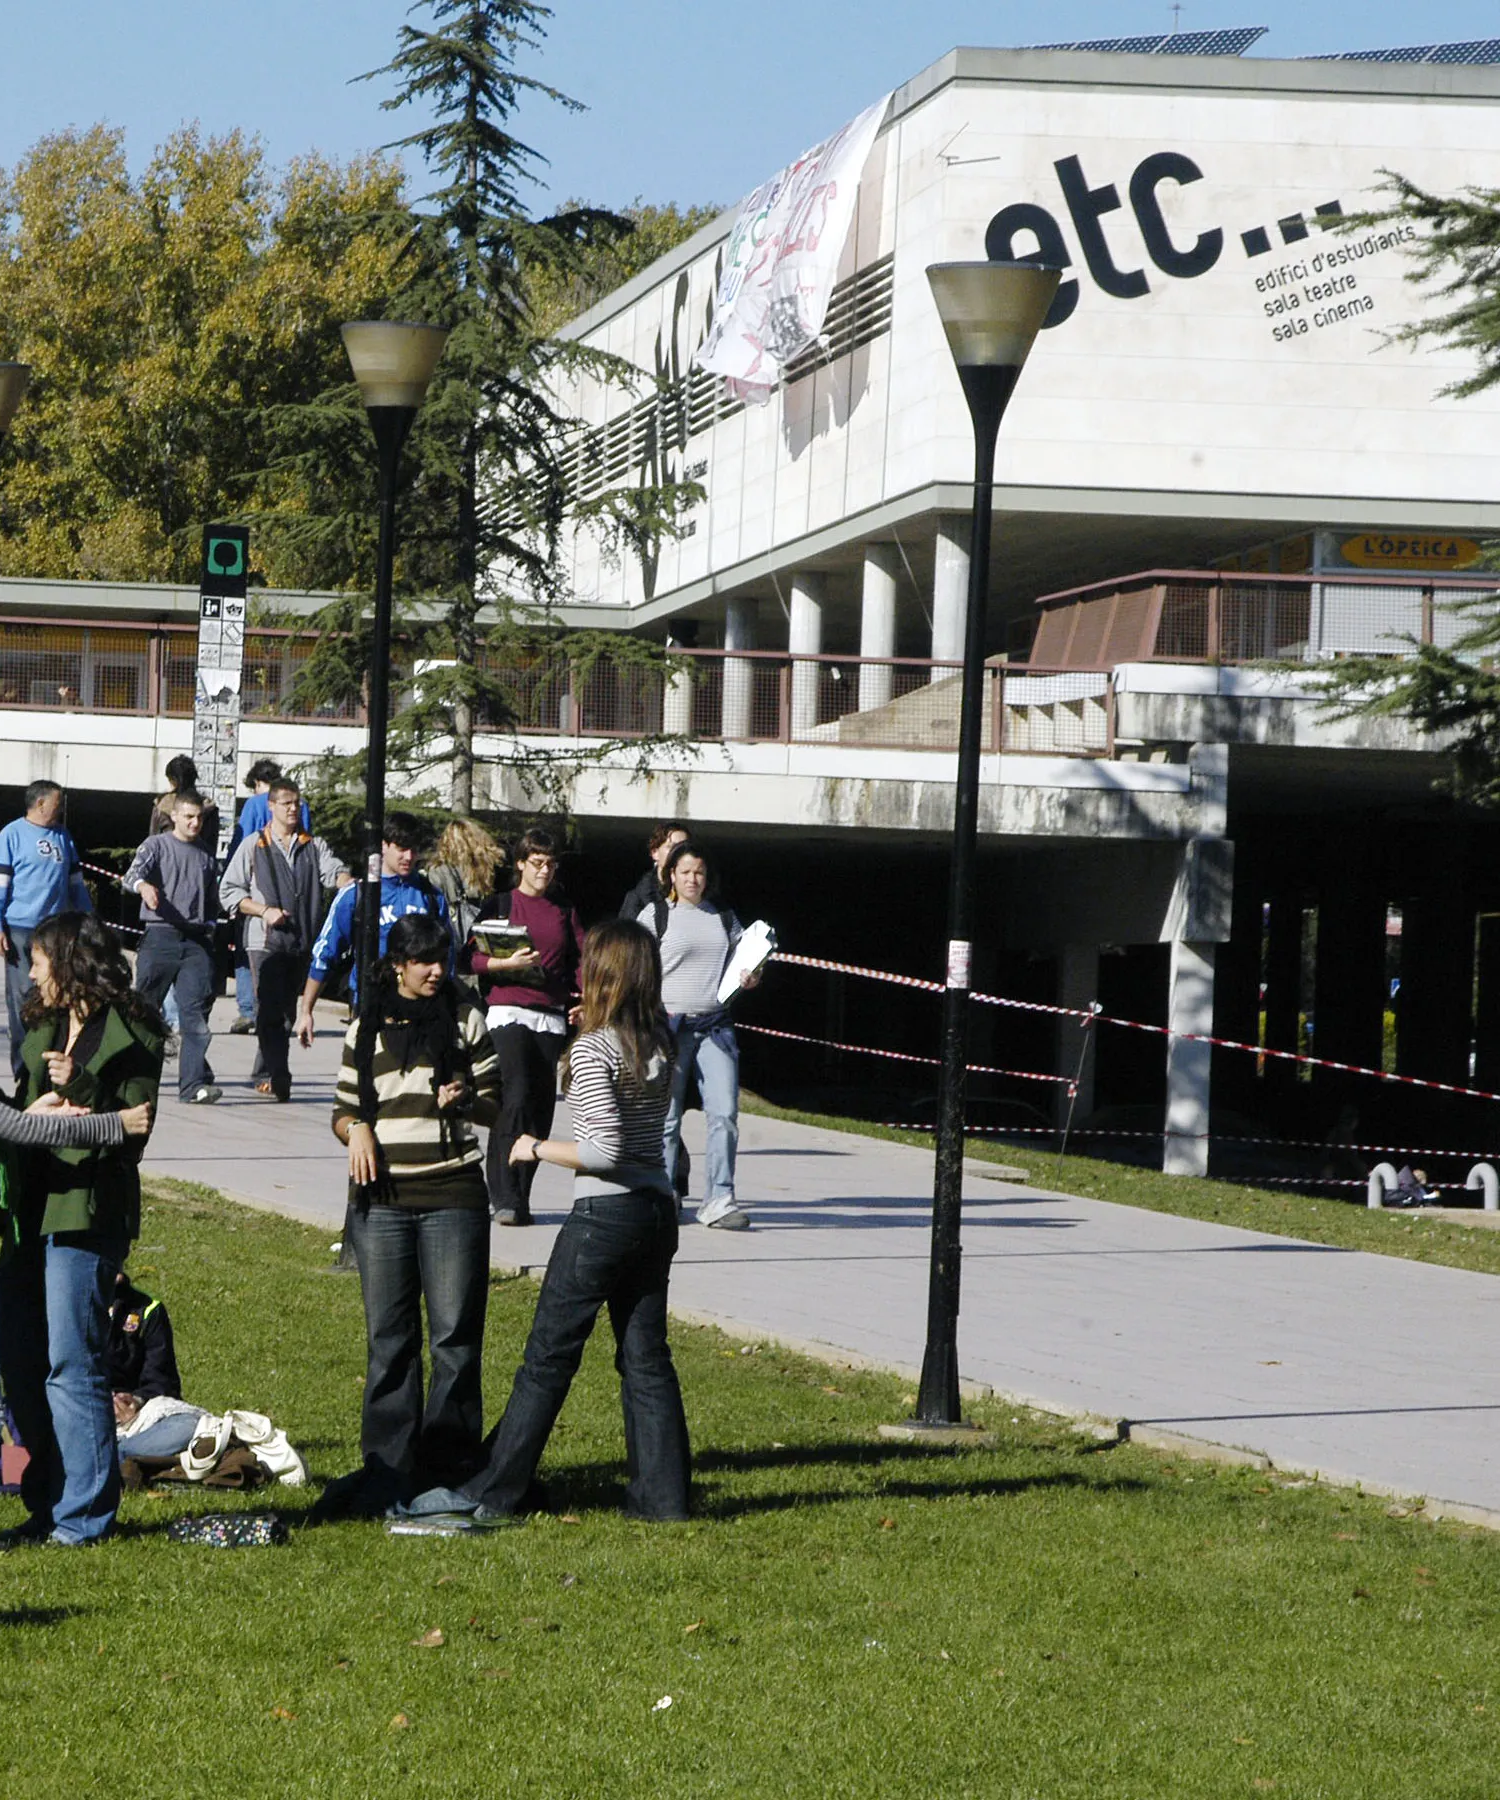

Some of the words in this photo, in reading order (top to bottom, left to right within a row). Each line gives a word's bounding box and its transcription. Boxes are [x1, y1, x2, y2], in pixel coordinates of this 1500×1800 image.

[1255, 259, 1309, 292] edifici
[1312, 224, 1416, 273] d'estudiants
[1264, 292, 1300, 317] sala
[1304, 274, 1357, 302] teatre
[1272, 318, 1308, 342] sala
[1314, 294, 1374, 328] cinema
